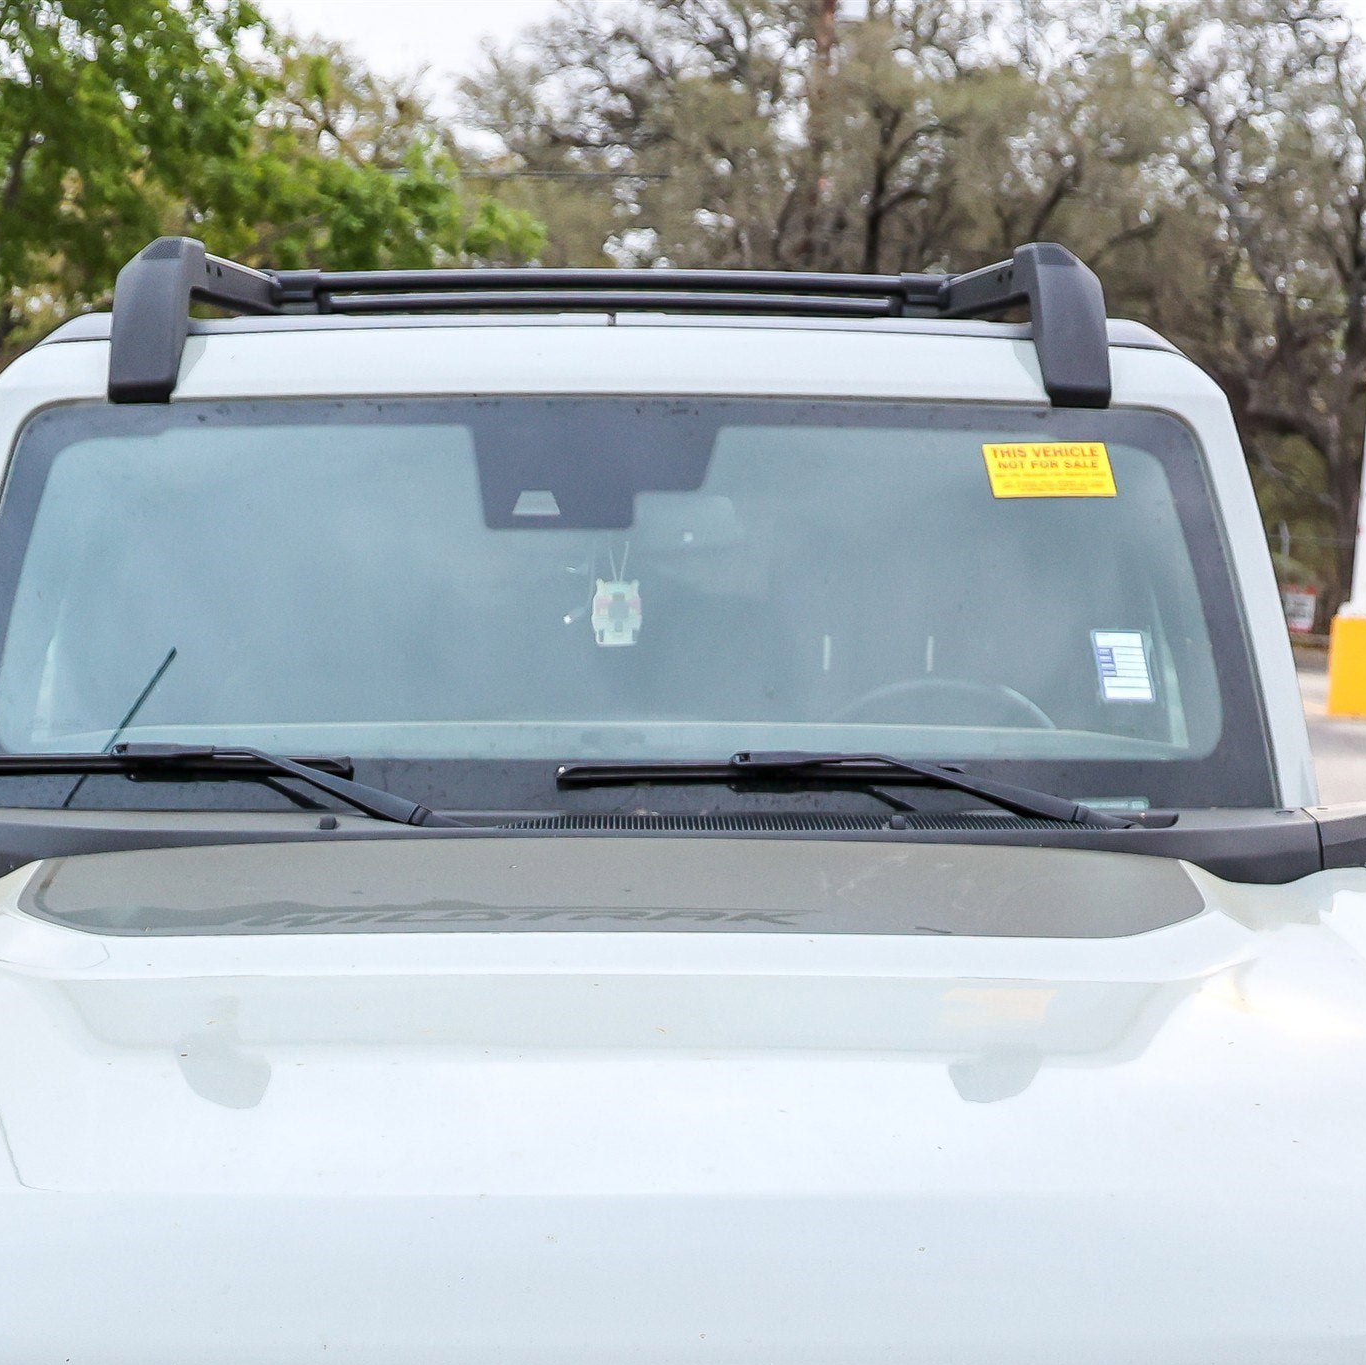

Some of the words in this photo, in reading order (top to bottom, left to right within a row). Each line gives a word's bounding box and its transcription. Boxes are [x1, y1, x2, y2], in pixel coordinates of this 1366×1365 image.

[991, 447, 1027, 459] THIS
[1032, 446, 1099, 458] VEHICLE
[998, 460, 1026, 469] NOT
[1031, 460, 1059, 469] FOR
[1065, 459, 1099, 469] SALE
